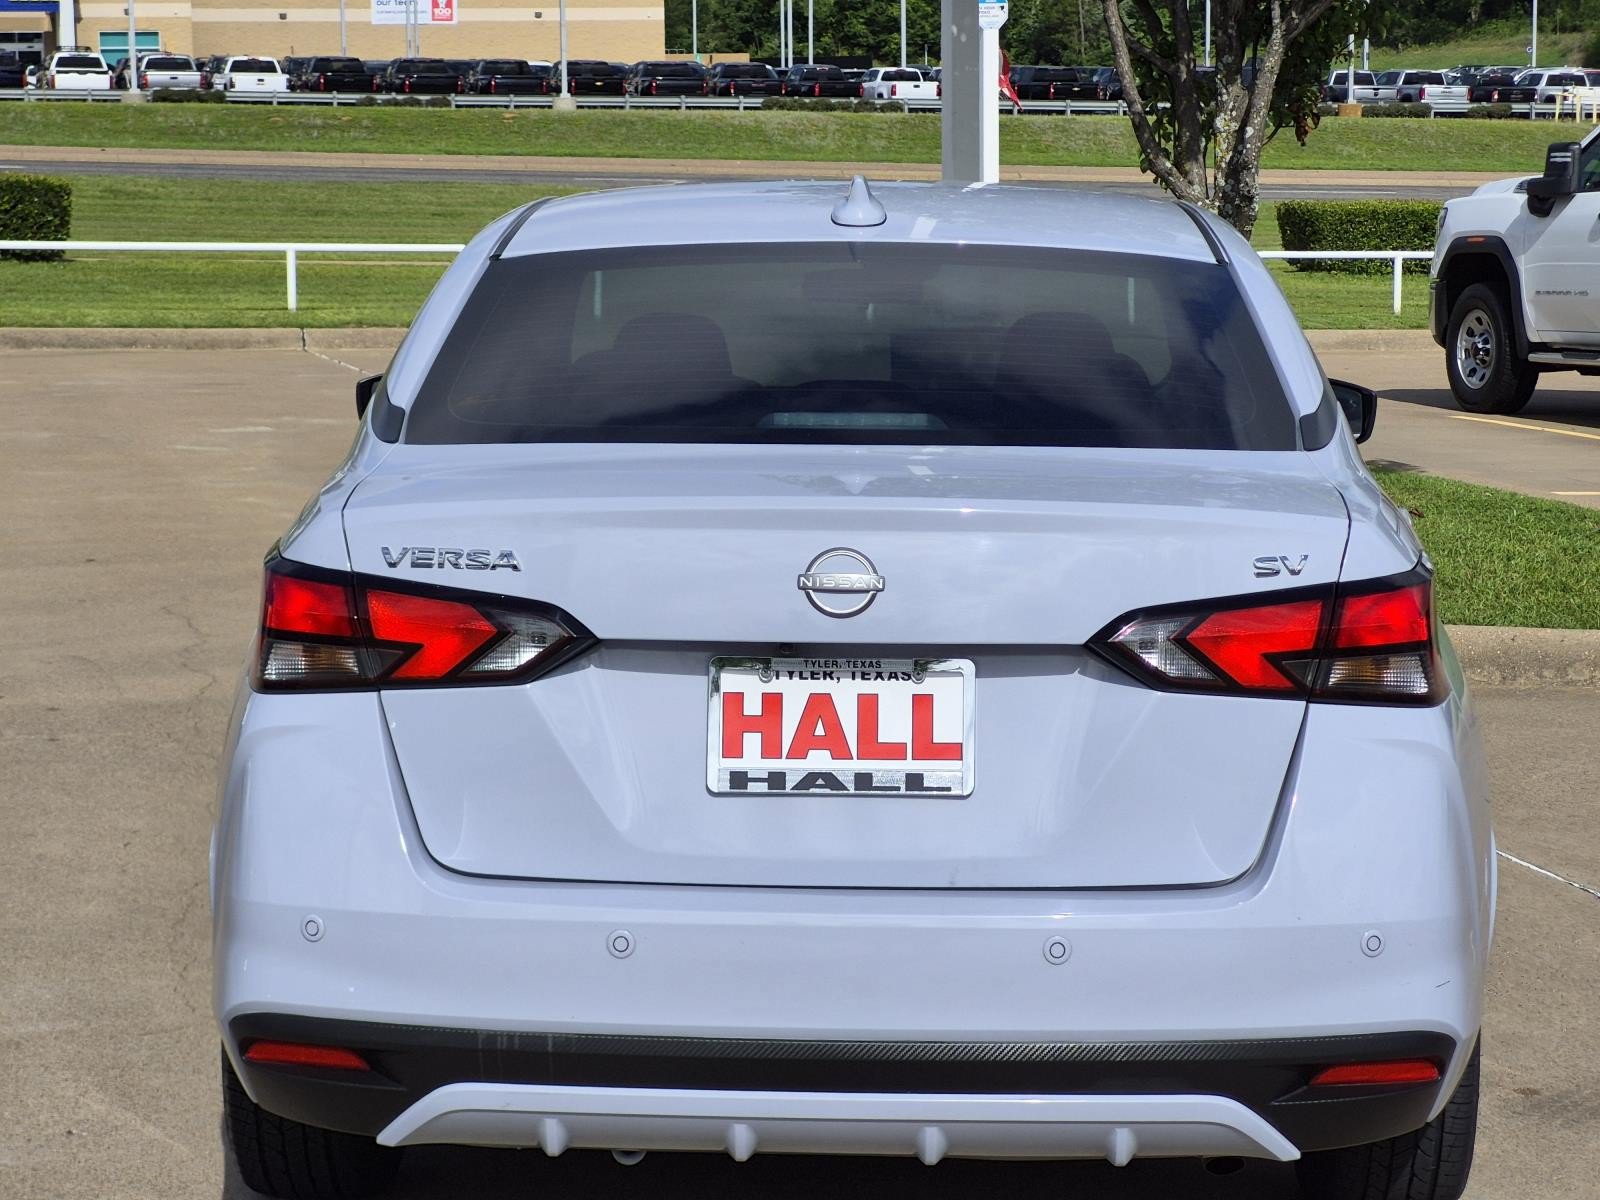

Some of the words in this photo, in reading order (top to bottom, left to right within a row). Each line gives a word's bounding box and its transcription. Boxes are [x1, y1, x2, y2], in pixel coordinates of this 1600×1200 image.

[381, 546, 521, 572] VERSA
[1253, 554, 1309, 578] SV
[799, 576, 883, 589] NISSAN
[803, 659, 842, 669] TYLER,
[846, 660, 882, 669] TEXAS
[851, 671, 912, 681] TEXAS
[722, 691, 963, 761] HALL
[729, 770, 952, 792] HALL
